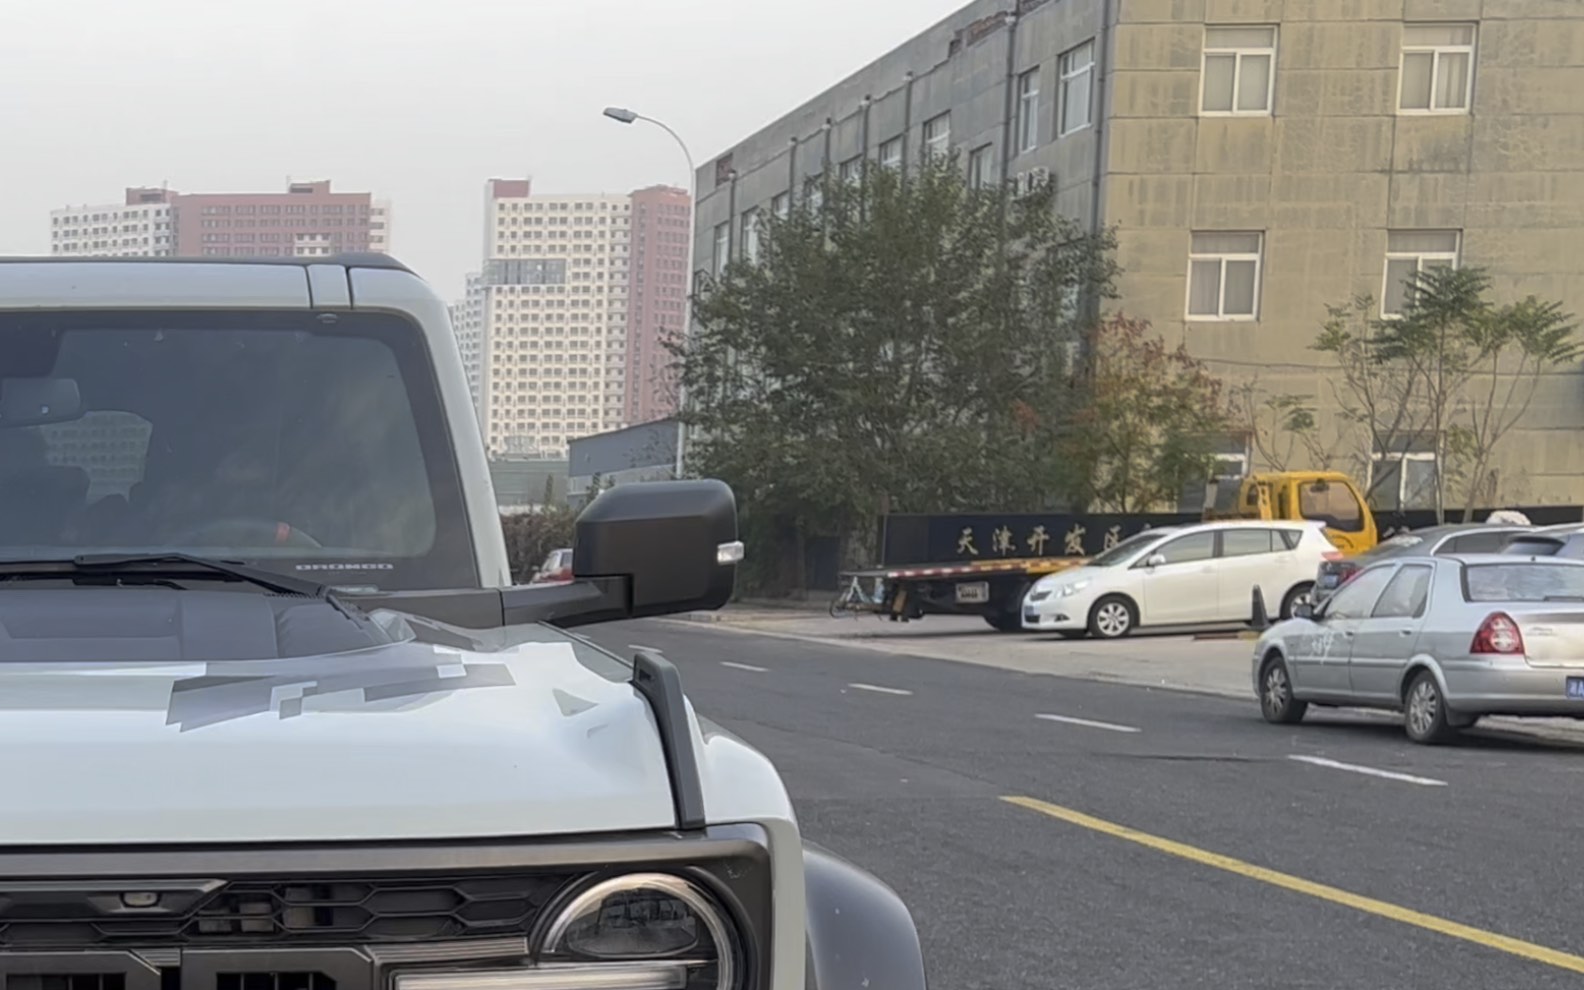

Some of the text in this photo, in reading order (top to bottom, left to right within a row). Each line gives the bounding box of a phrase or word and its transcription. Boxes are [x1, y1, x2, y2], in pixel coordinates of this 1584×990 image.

[957, 524, 1152, 556] 天津开发区
